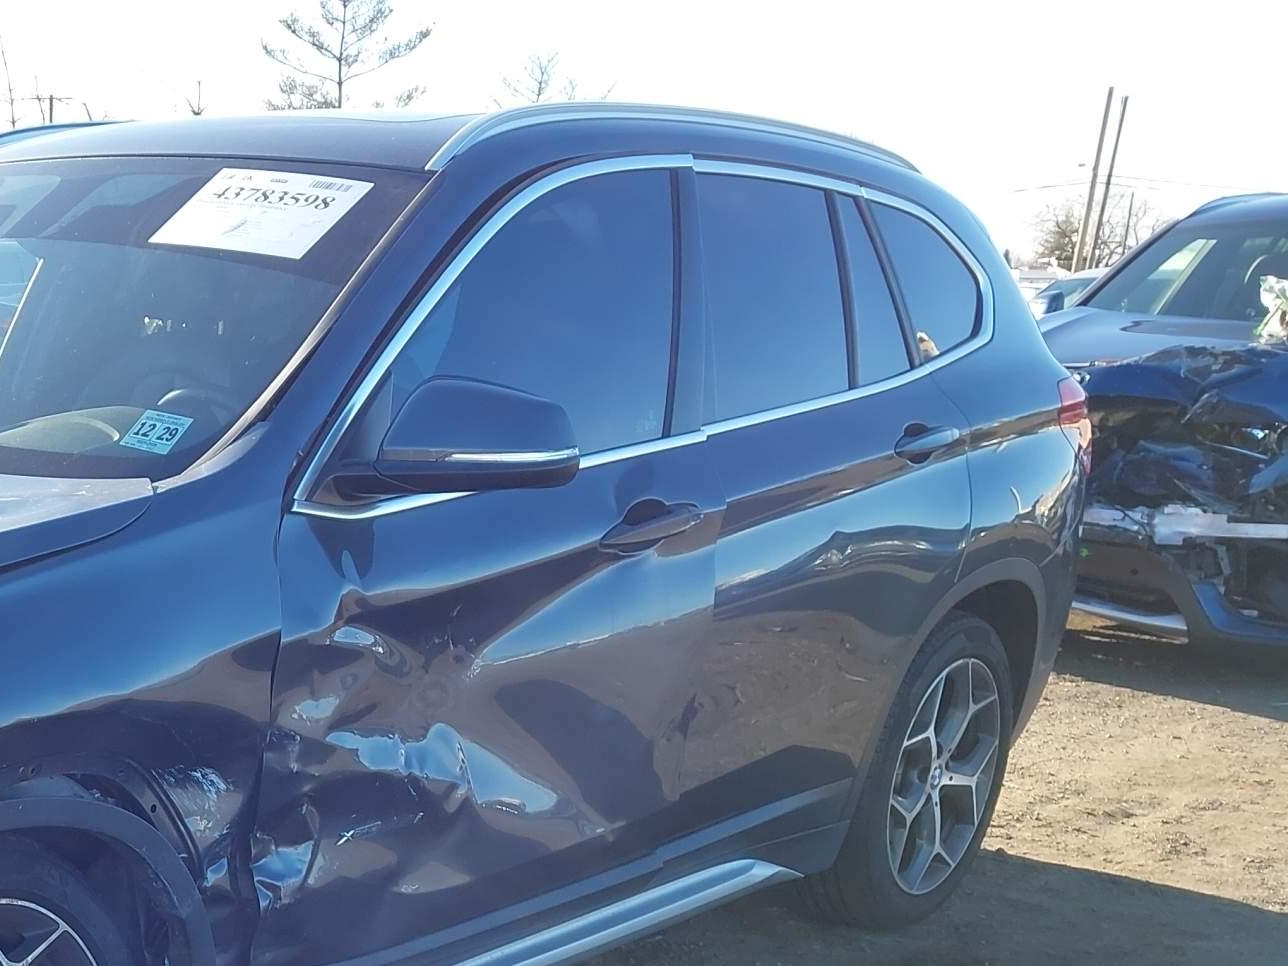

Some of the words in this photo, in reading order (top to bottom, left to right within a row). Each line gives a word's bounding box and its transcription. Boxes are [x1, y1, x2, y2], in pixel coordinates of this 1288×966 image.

[212, 184, 337, 211] 43783598
[132, 421, 157, 438] 12
[155, 426, 179, 443] 29
